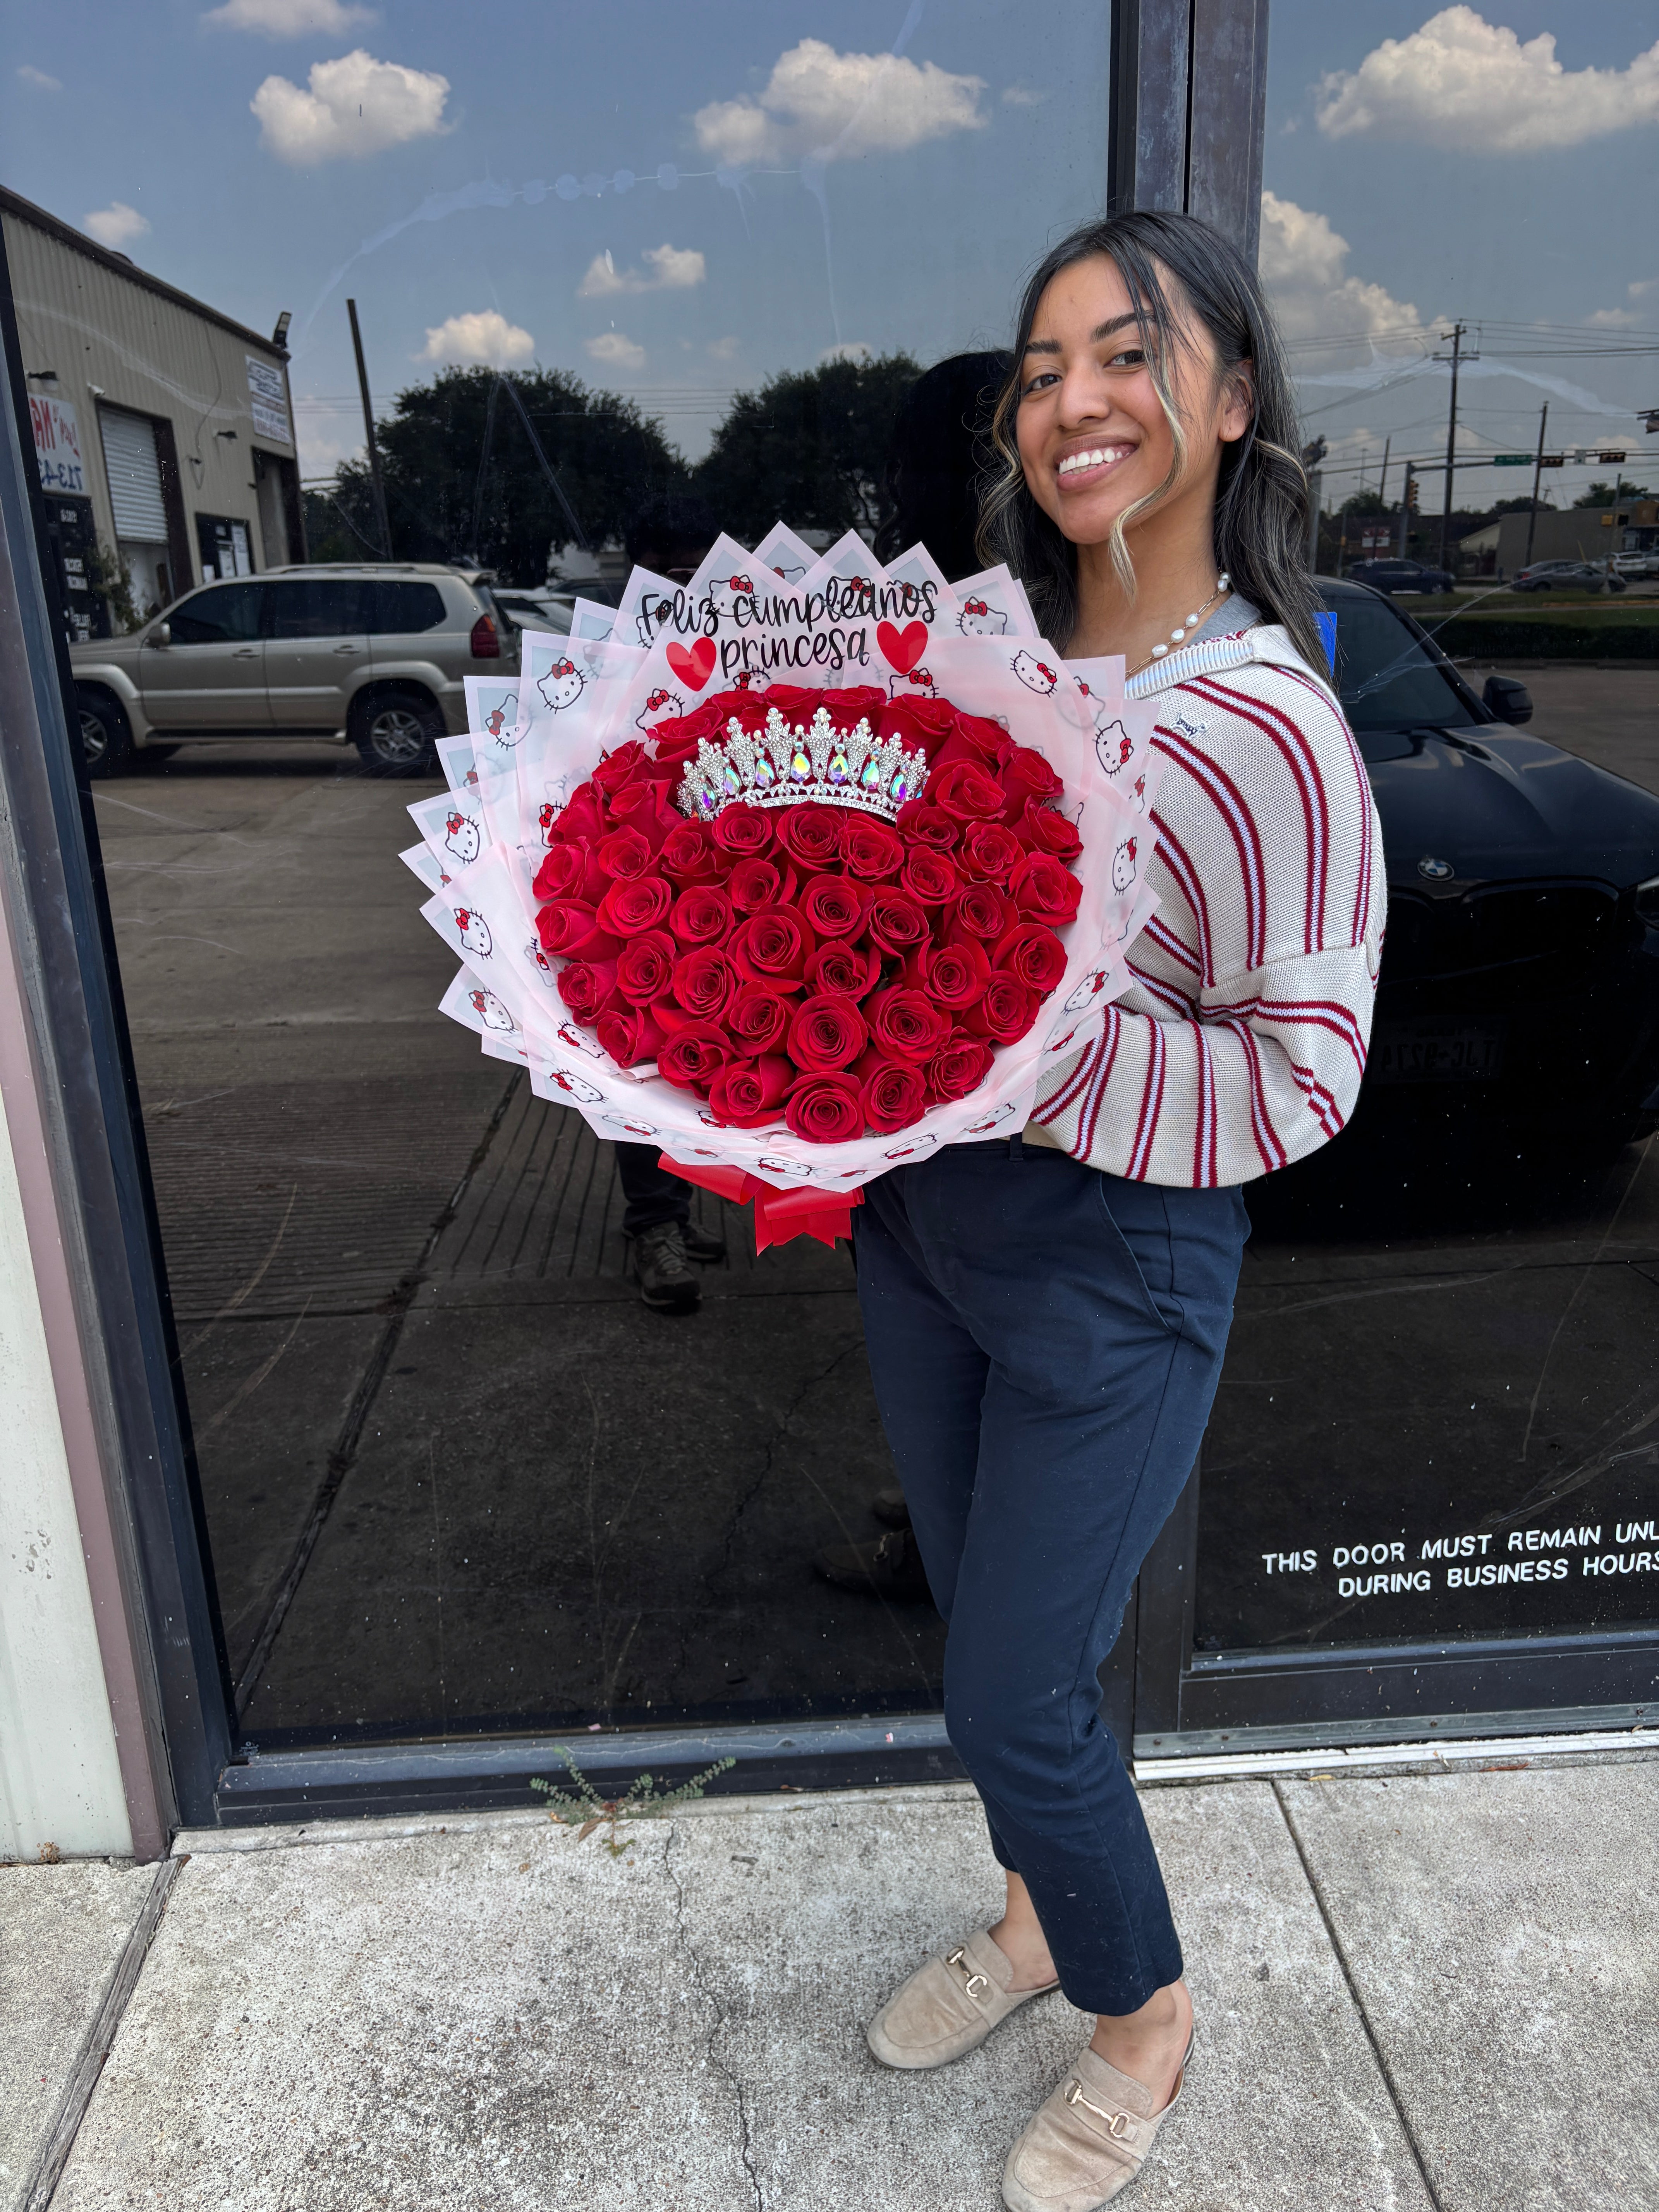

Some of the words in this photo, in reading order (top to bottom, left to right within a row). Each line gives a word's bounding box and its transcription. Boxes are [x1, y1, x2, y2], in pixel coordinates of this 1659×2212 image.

[641, 589, 720, 637] Feliz
[733, 576, 938, 632] cumpleaños
[721, 628, 869, 678] princesa
[1262, 1549, 1317, 1574] THIS
[1333, 1542, 1405, 1568] DOOR
[1421, 1534, 1492, 1559] MUST
[1508, 1525, 1601, 1551] REMAIN
[1338, 1570, 1431, 1597] DURING
[1447, 1558, 1568, 1588] BUSINESS
